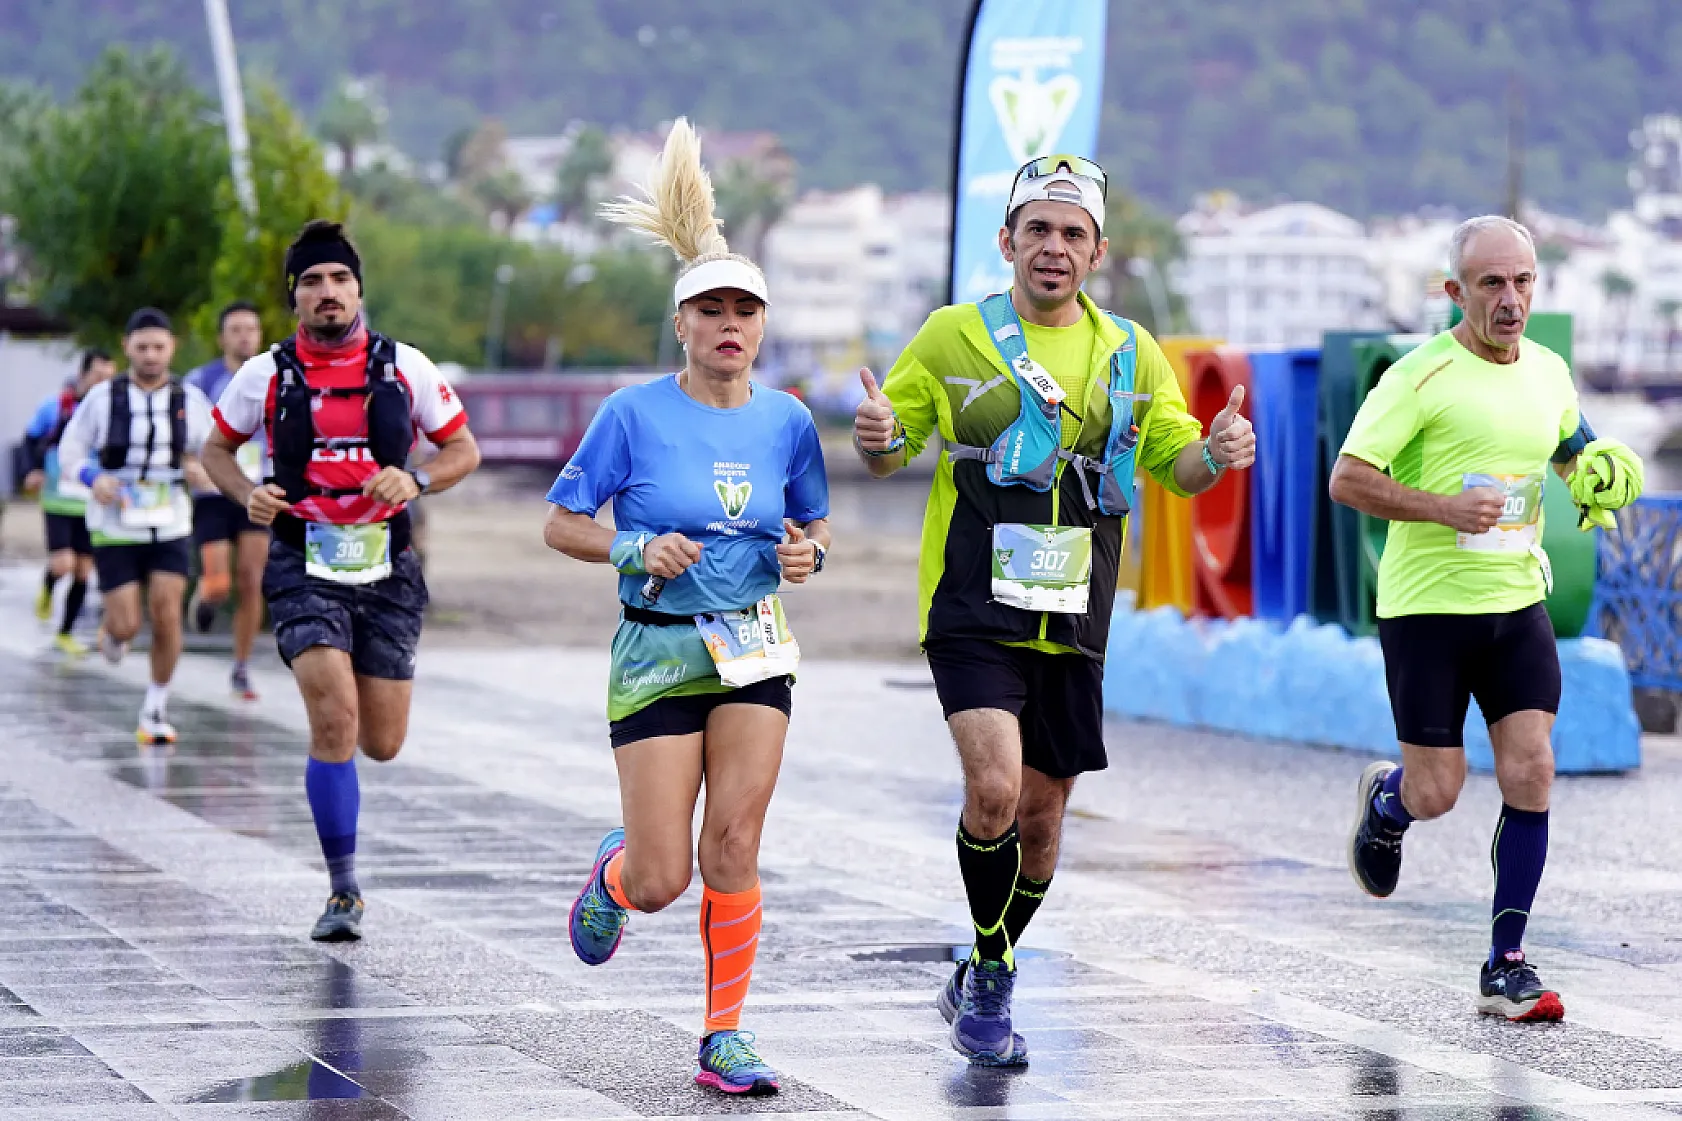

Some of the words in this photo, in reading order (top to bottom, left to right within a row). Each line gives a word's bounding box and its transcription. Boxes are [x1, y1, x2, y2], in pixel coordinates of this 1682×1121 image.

[1032, 375, 1054, 392] 307
[1502, 496, 1526, 515] 00
[336, 542, 364, 558] 310
[1030, 550, 1071, 571] 307
[738, 621, 760, 645] 64
